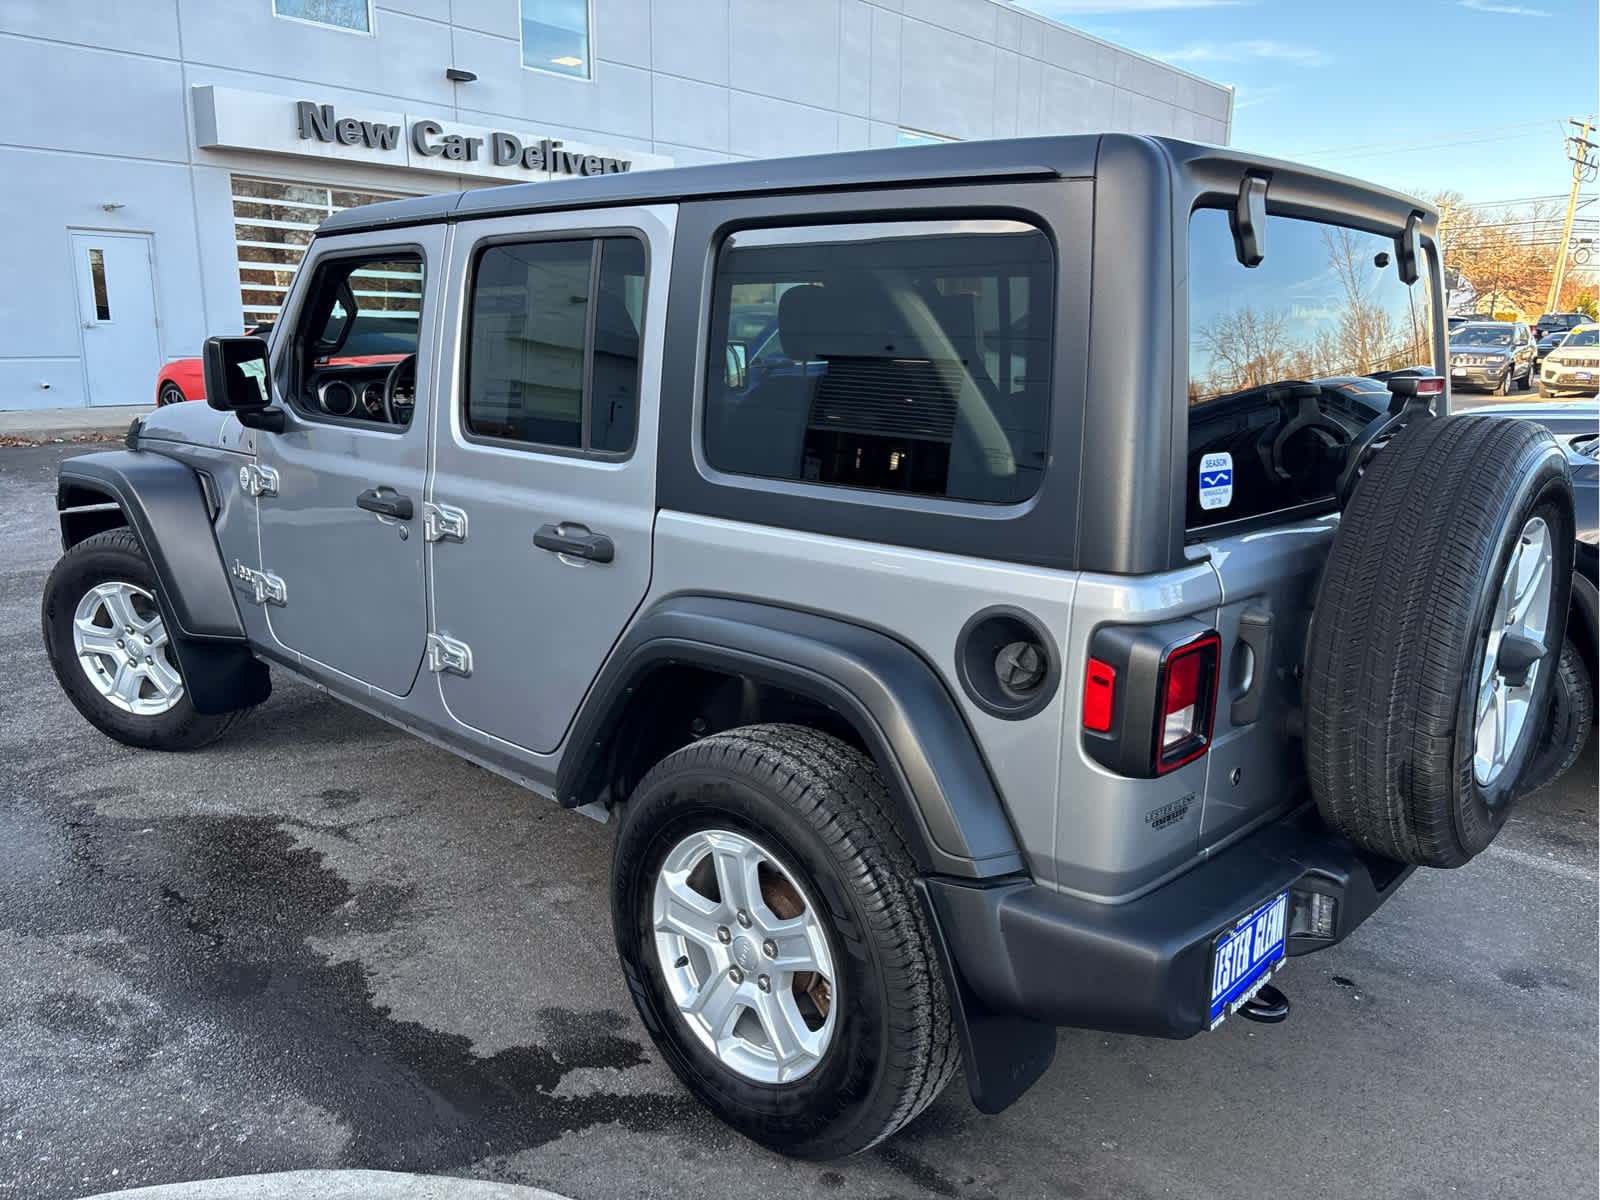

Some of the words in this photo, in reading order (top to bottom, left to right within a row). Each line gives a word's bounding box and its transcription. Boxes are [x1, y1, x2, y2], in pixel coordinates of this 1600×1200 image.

[297, 101, 400, 150] New
[412, 120, 483, 161] Car
[493, 132, 632, 176] Delivery
[1205, 458, 1227, 468] SEASON
[1212, 926, 1252, 1000] LESTER
[1253, 897, 1286, 962] GLENN
